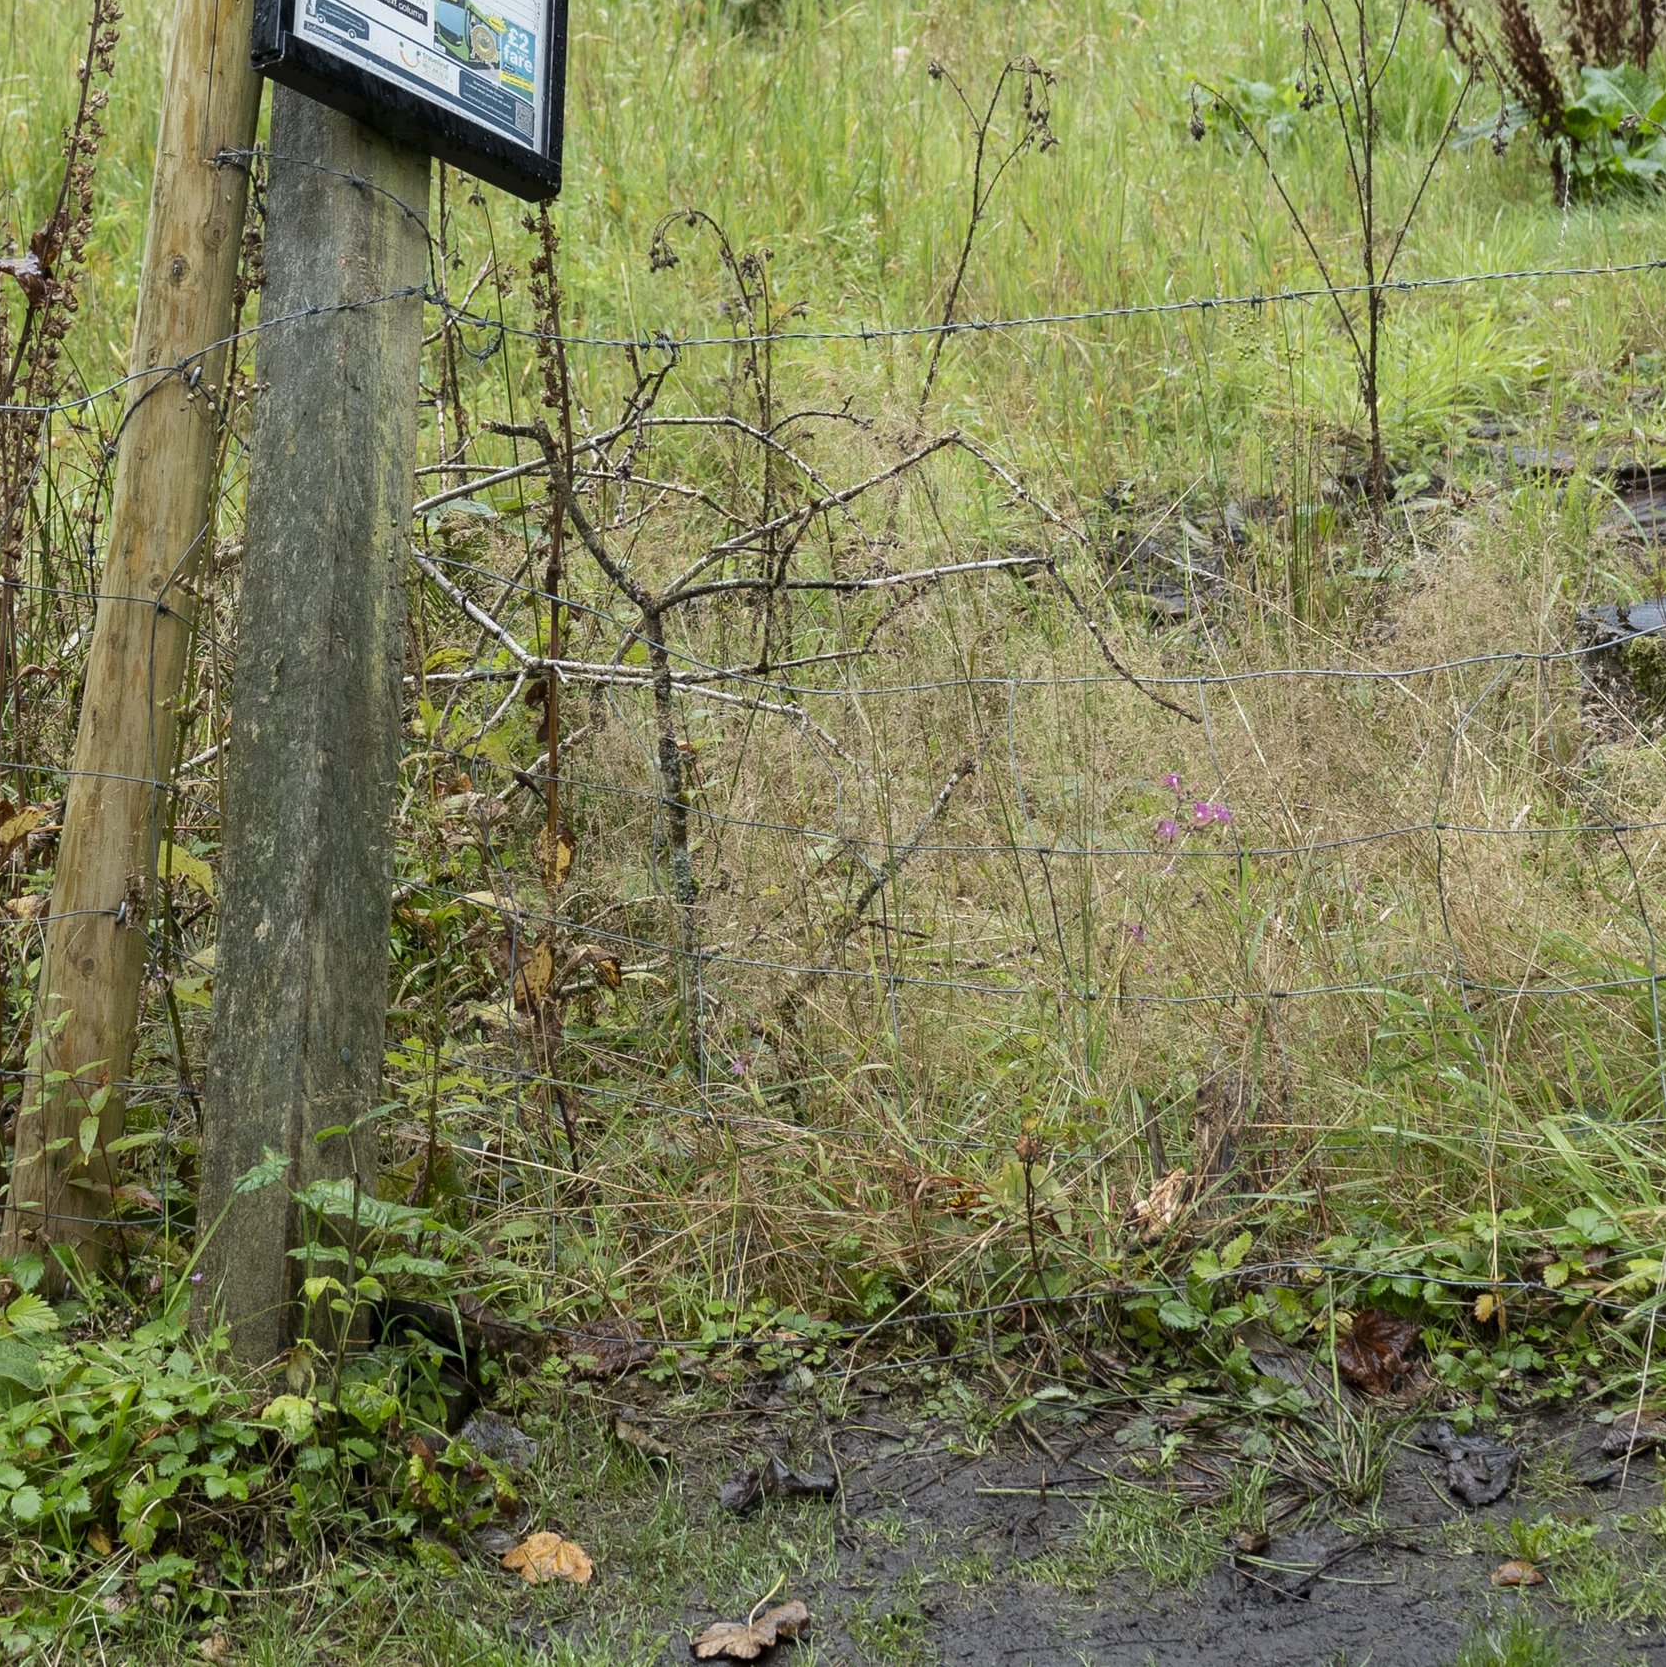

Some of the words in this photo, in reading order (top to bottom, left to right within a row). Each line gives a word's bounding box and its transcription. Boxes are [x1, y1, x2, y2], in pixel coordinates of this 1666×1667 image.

[398, 0, 425, 22] column
[508, 28, 530, 55] £2
[504, 44, 534, 74] fare
